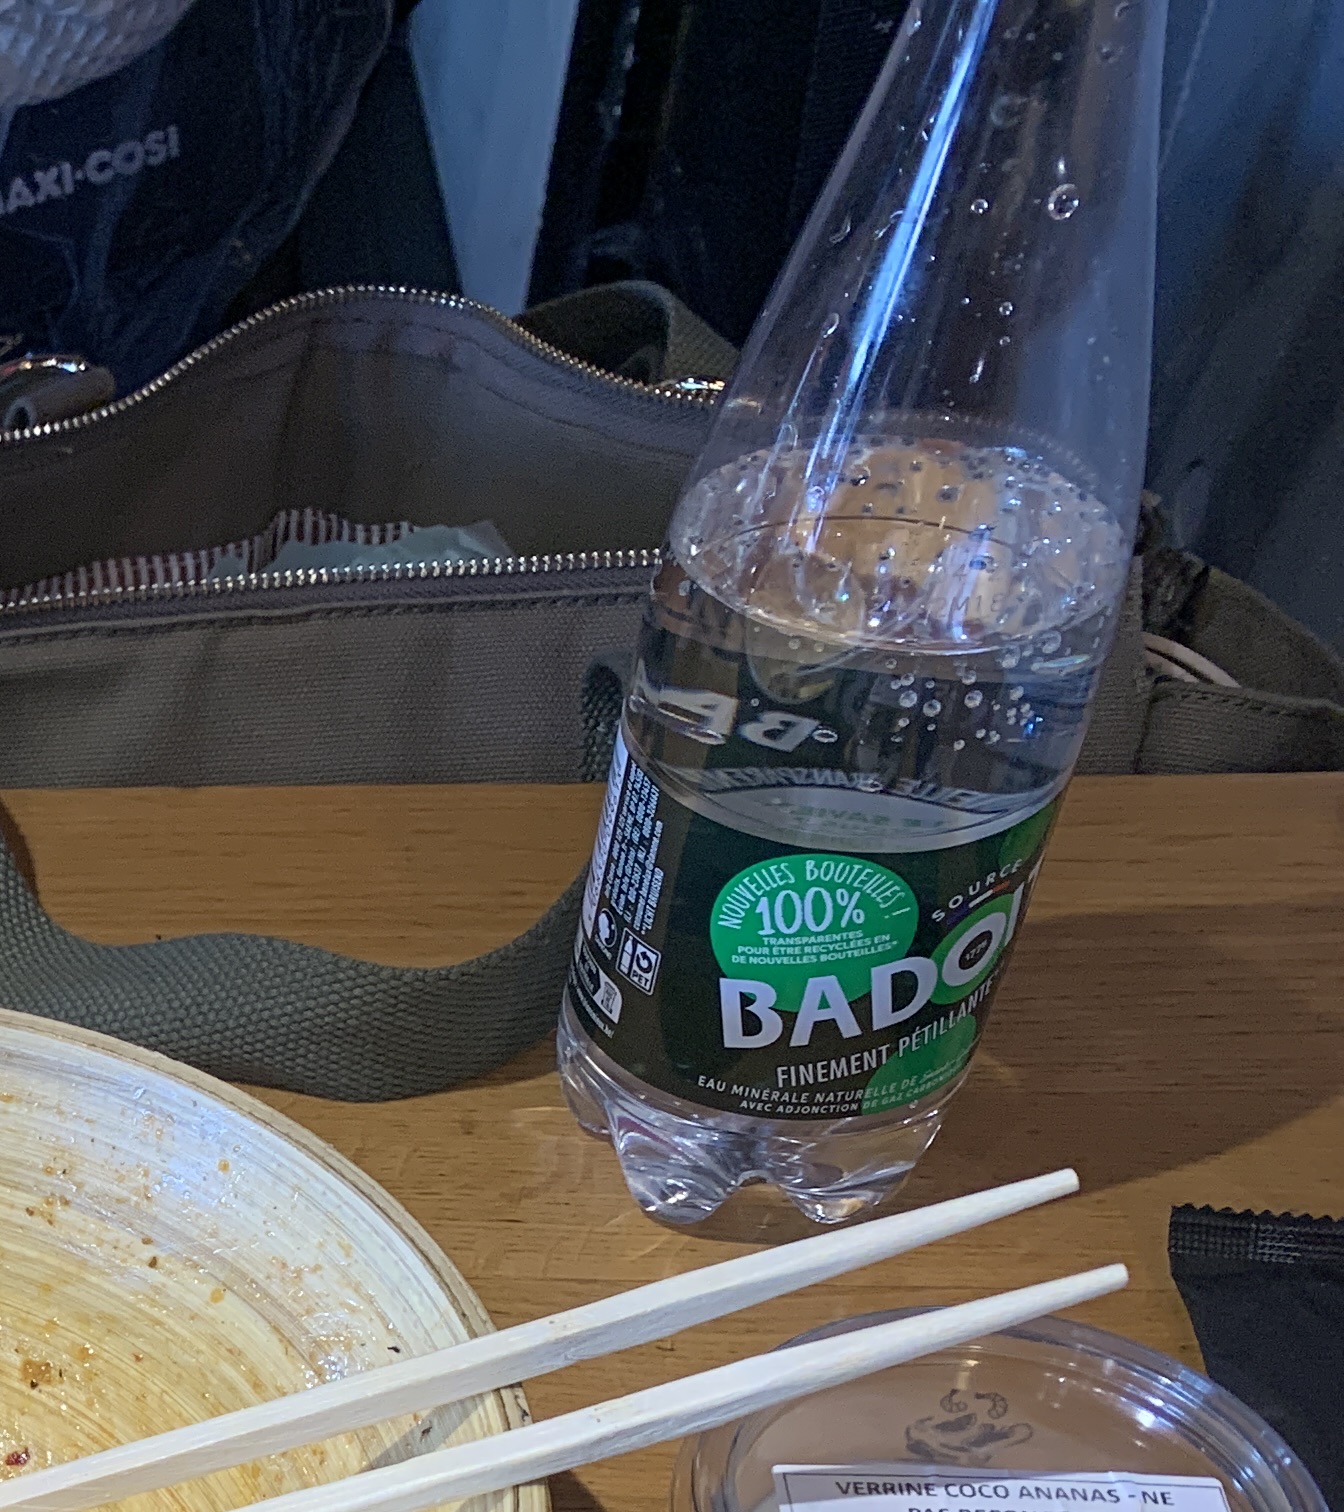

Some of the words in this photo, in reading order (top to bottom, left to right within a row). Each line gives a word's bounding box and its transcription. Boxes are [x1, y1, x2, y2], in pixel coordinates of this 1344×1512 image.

[717, 862, 796, 930] NOUVELLES
[805, 859, 906, 909] BOUTEILLES
[931, 858, 1023, 922] SOURCE
[755, 886, 865, 935] 100%
[737, 945, 770, 955] POUR
[772, 943, 802, 955] ÊTRE
[804, 937, 872, 954] RECYCLÉES
[874, 933, 891, 945] EN
[762, 930, 864, 946] TRANSPARENTES
[731, 955, 747, 964] DE
[749, 954, 818, 965] NOUVELLES
[631, 968, 650, 990] PET
[776, 1044, 891, 1088] FINEMENT
[697, 1075, 727, 1092] EAU
[730, 1083, 809, 1104] MINÉRALE
[813, 1082, 898, 1104] NATURELLE
[900, 1075, 918, 1090] DE
[739, 1099, 773, 1113] AVEC
[775, 1102, 859, 1115] ADJONCTION
[862, 1098, 879, 1110] DE
[881, 1091, 904, 1107] GAZ
[835, 1480, 938, 1498] VERRINE
[944, 1483, 1010, 1499] COCO
[1018, 1485, 1121, 1504] ANANAS
[1141, 1489, 1176, 1507] NE
